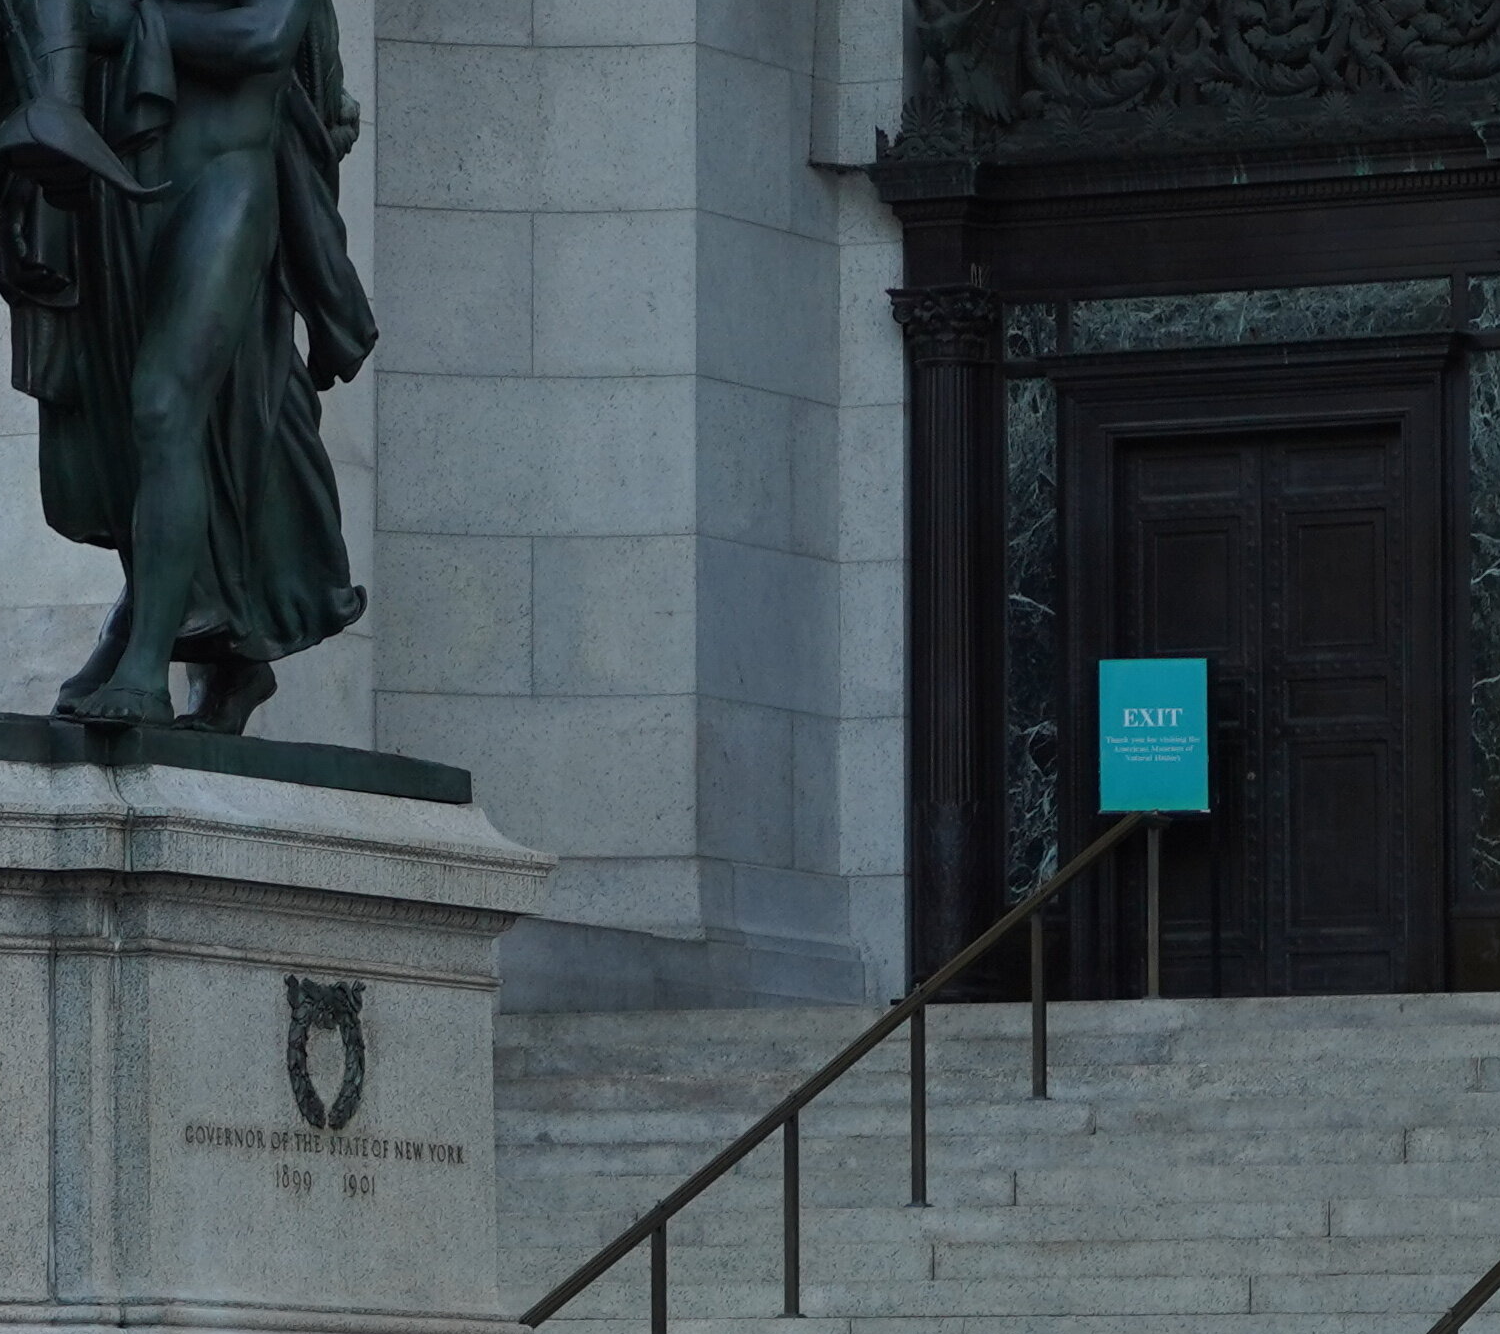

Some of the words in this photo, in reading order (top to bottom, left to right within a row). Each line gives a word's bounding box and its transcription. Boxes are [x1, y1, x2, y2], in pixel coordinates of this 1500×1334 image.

[1123, 708, 1183, 727] EXIT
[185, 1124, 265, 1149] GOVERNOR
[271, 1131, 289, 1150] OF
[294, 1132, 323, 1154] THE
[329, 1136, 368, 1157] STATE
[373, 1138, 391, 1158] OF
[395, 1142, 424, 1161] NEW
[428, 1143, 464, 1165] YORK
[275, 1164, 312, 1194] 1899
[343, 1173, 376, 1197] 1901
